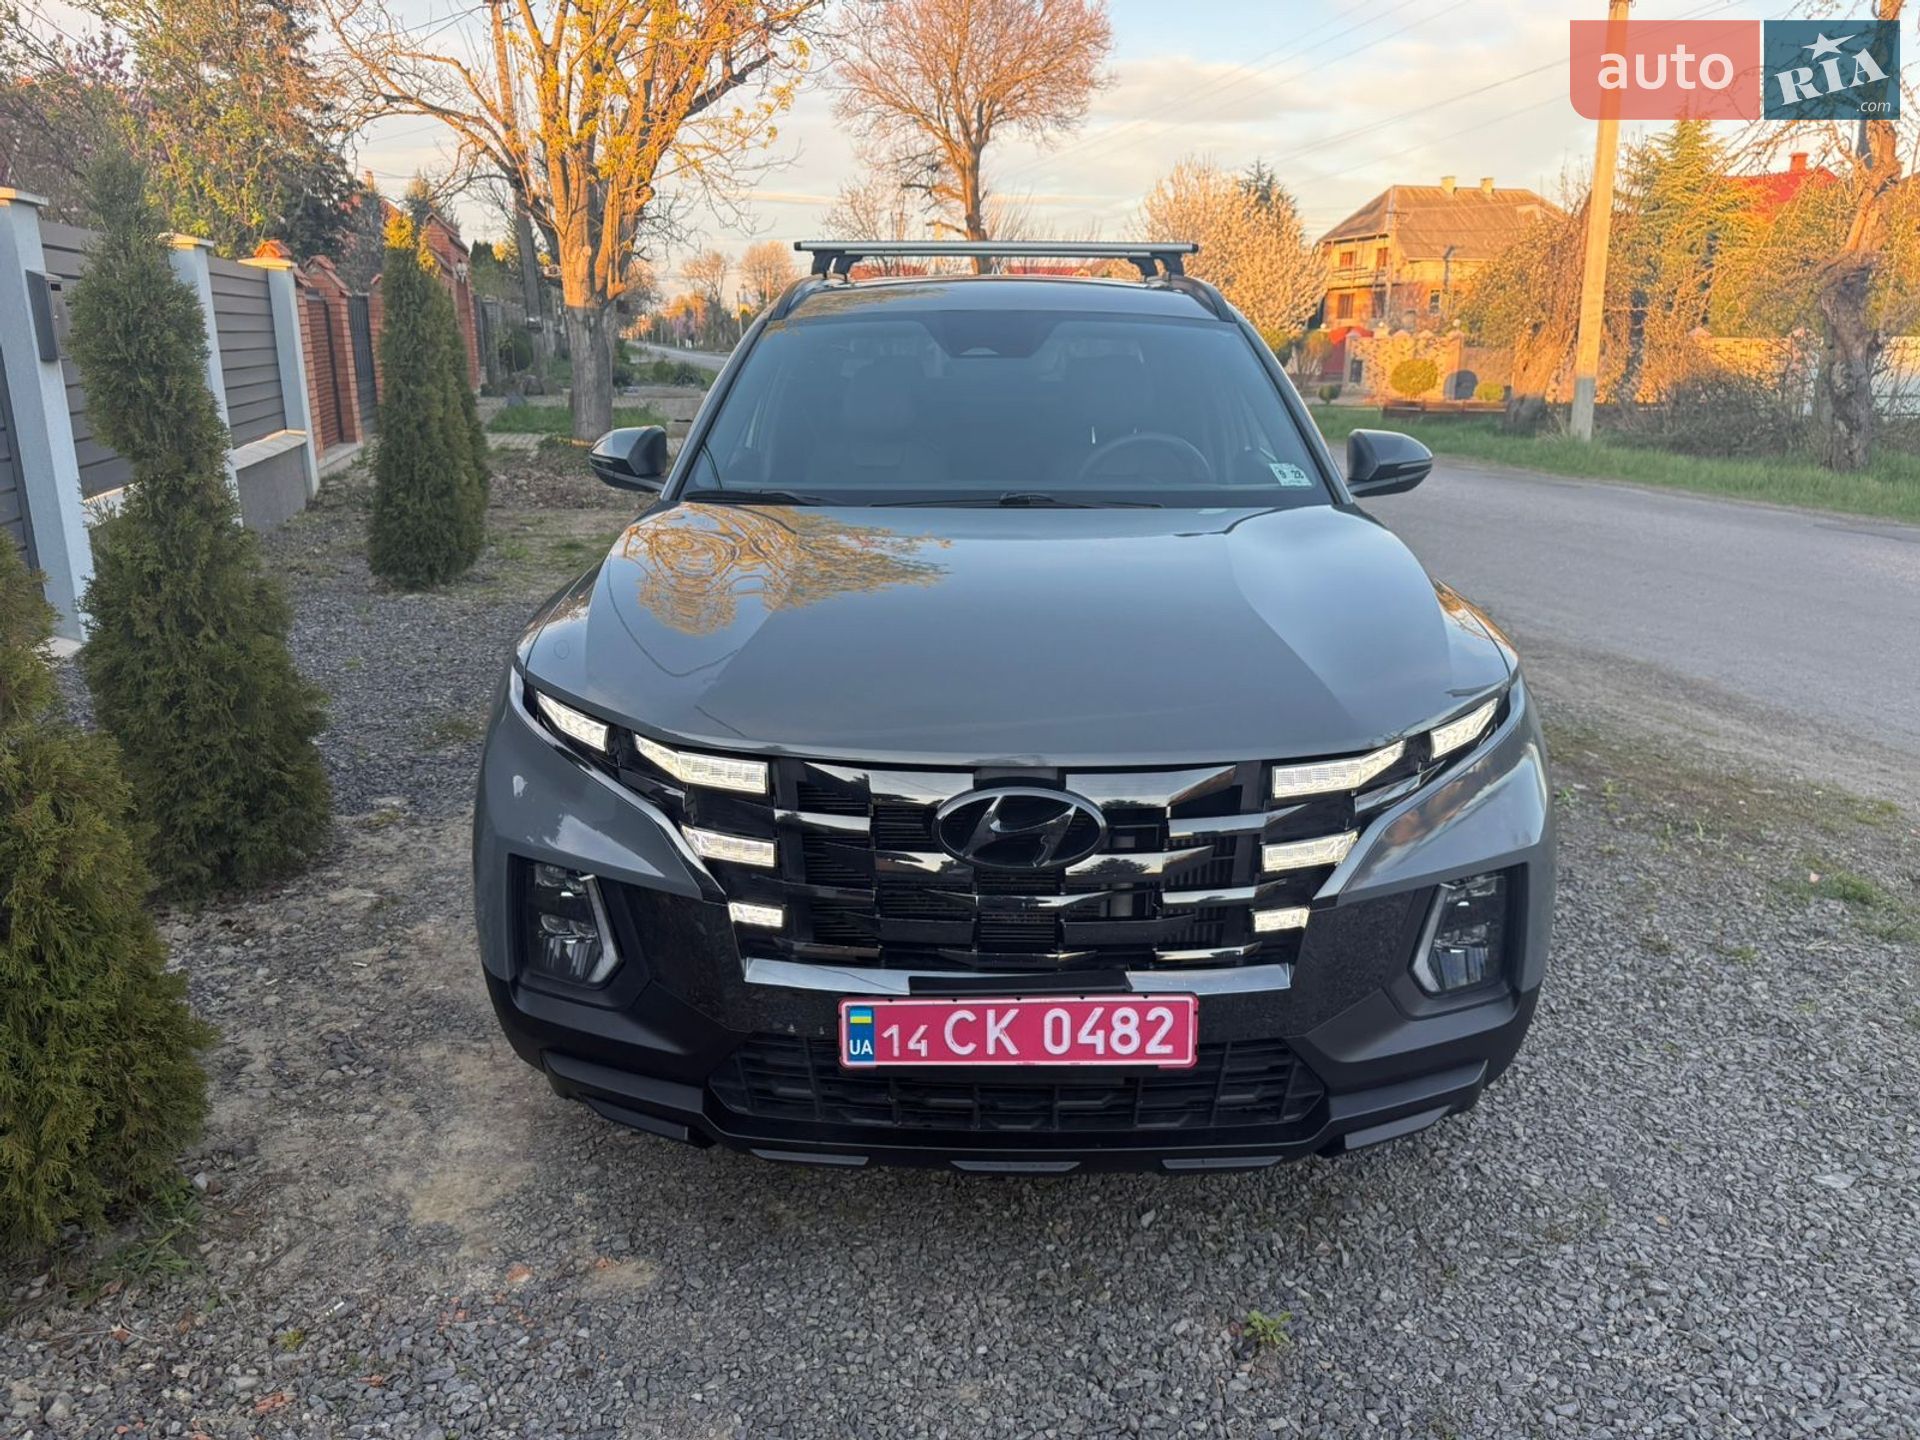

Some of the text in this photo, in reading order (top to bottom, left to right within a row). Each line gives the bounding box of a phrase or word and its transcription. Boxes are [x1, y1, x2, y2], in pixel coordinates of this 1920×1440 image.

[849, 1039, 873, 1055] UA
[881, 1007, 1174, 1057] 14 CK 0482
